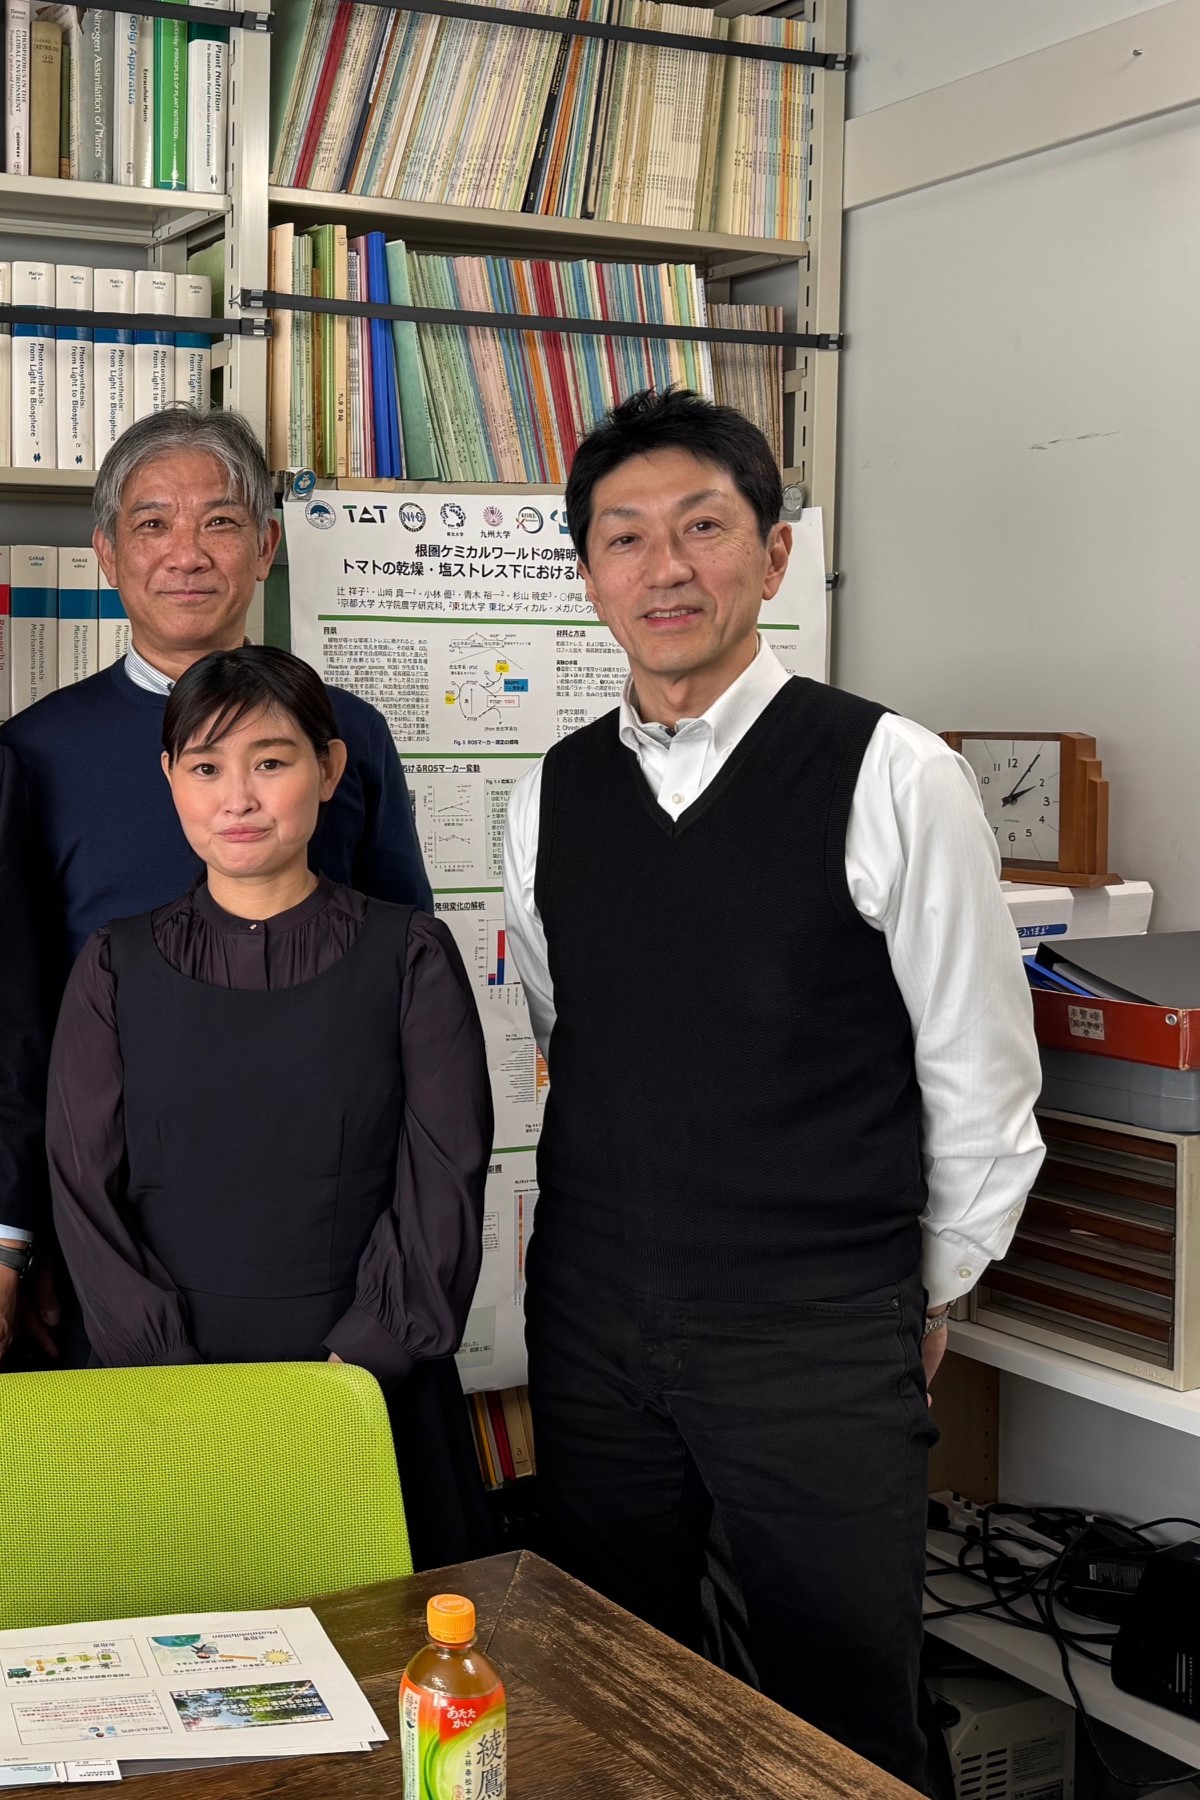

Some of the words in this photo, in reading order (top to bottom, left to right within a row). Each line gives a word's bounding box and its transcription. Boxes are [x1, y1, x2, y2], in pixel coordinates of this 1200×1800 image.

[92, 9, 102, 51] Nitrogen
[127, 16, 138, 44] Golgi
[128, 48, 137, 105] Apparatus
[94, 55, 103, 113] Assimilation
[94, 115, 103, 127] of
[94, 128, 103, 157] Plants
[480, 530, 511, 539] 九州大学
[415, 545, 577, 562] 根圏ケミカルワールドの解明
[37, 624, 45, 683] Photosynthesis:
[993, 763, 1001, 772] 11
[1007, 758, 1018, 768] 12
[981, 776, 990, 785] 10
[1039, 779, 1045, 787] 2
[1043, 797, 1051, 806] 3
[1038, 815, 1045, 824] 4
[1008, 832, 1016, 842] 6
[1025, 829, 1032, 838] 5
[447, 1706, 476, 1719] あたた
[453, 1719, 473, 1729] かい
[476, 1728, 503, 1800] 綾鷹
